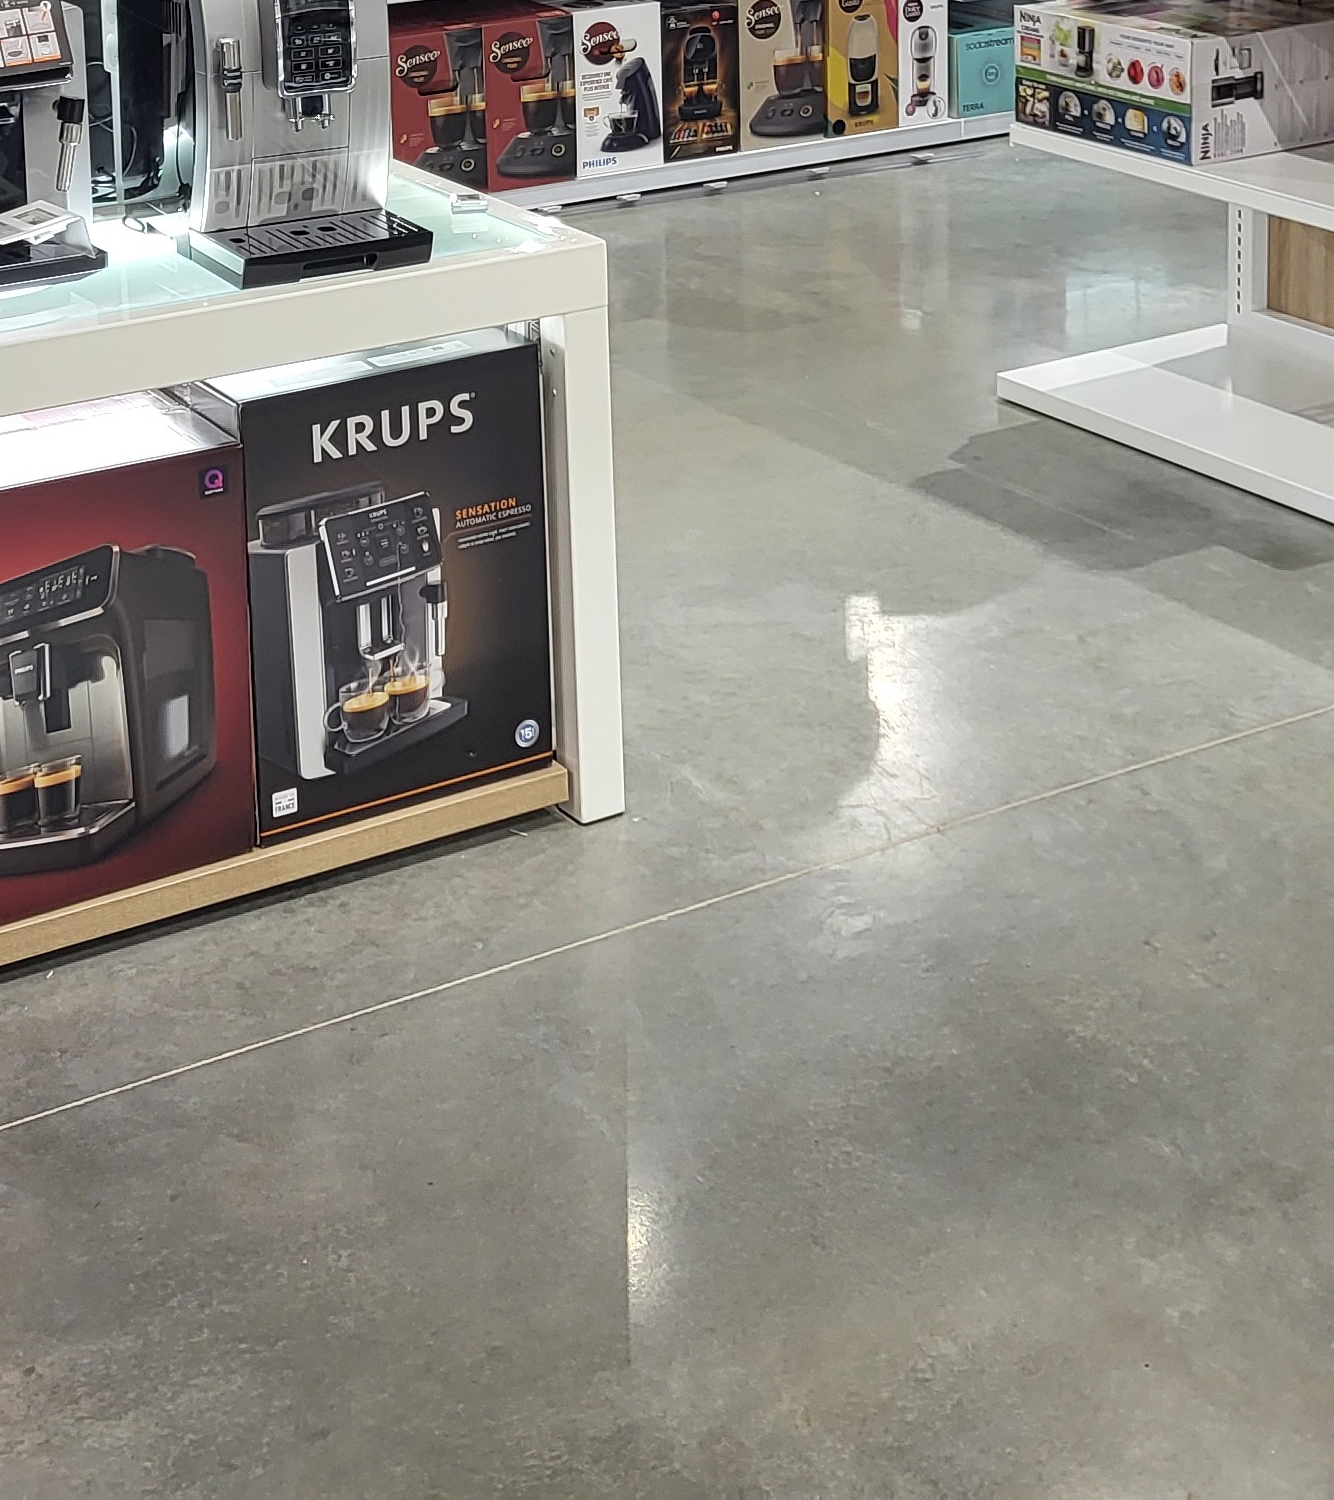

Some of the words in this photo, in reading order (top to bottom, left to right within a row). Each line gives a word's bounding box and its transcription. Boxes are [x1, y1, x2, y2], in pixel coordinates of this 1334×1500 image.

[745, 4, 781, 29] Senseo
[490, 37, 534, 63] Senseo
[580, 28, 621, 55] Senseo
[396, 50, 441, 77] Senseo
[961, 102, 985, 113] TERRA
[1199, 122, 1211, 161] NINJA
[582, 156, 618, 170] PHILIPS
[311, 391, 475, 464] KRUPS
[455, 497, 517, 520] SENSATION
[455, 513, 497, 529] AUTOMATIC
[498, 504, 532, 519] ESPRESSO
